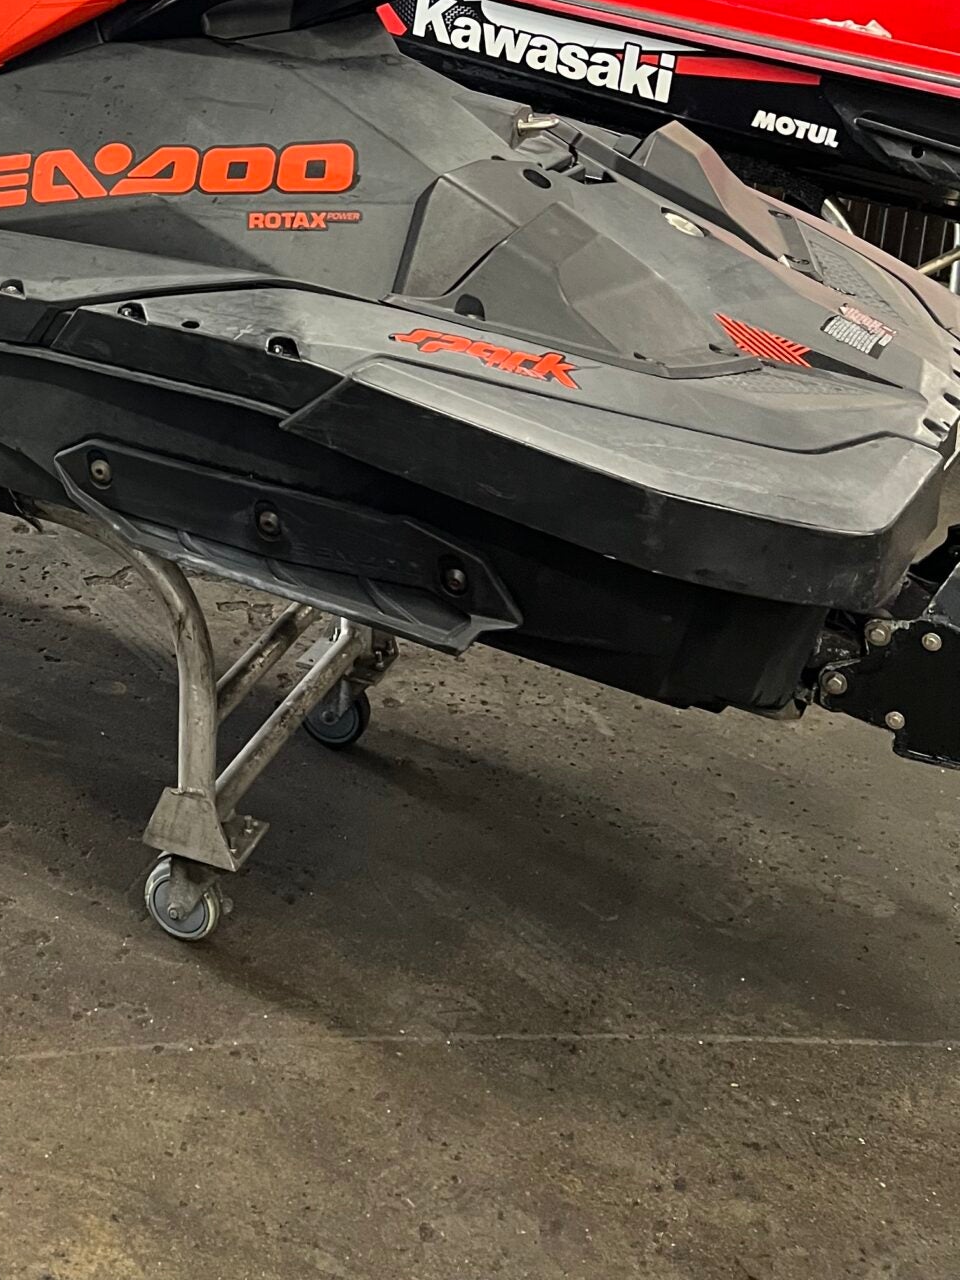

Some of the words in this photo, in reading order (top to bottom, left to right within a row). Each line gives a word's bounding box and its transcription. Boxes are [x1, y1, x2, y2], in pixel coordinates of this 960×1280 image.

[751, 109, 839, 148] MOTUL
[248, 211, 327, 229] ROTAX
[327, 212, 360, 220] POWER
